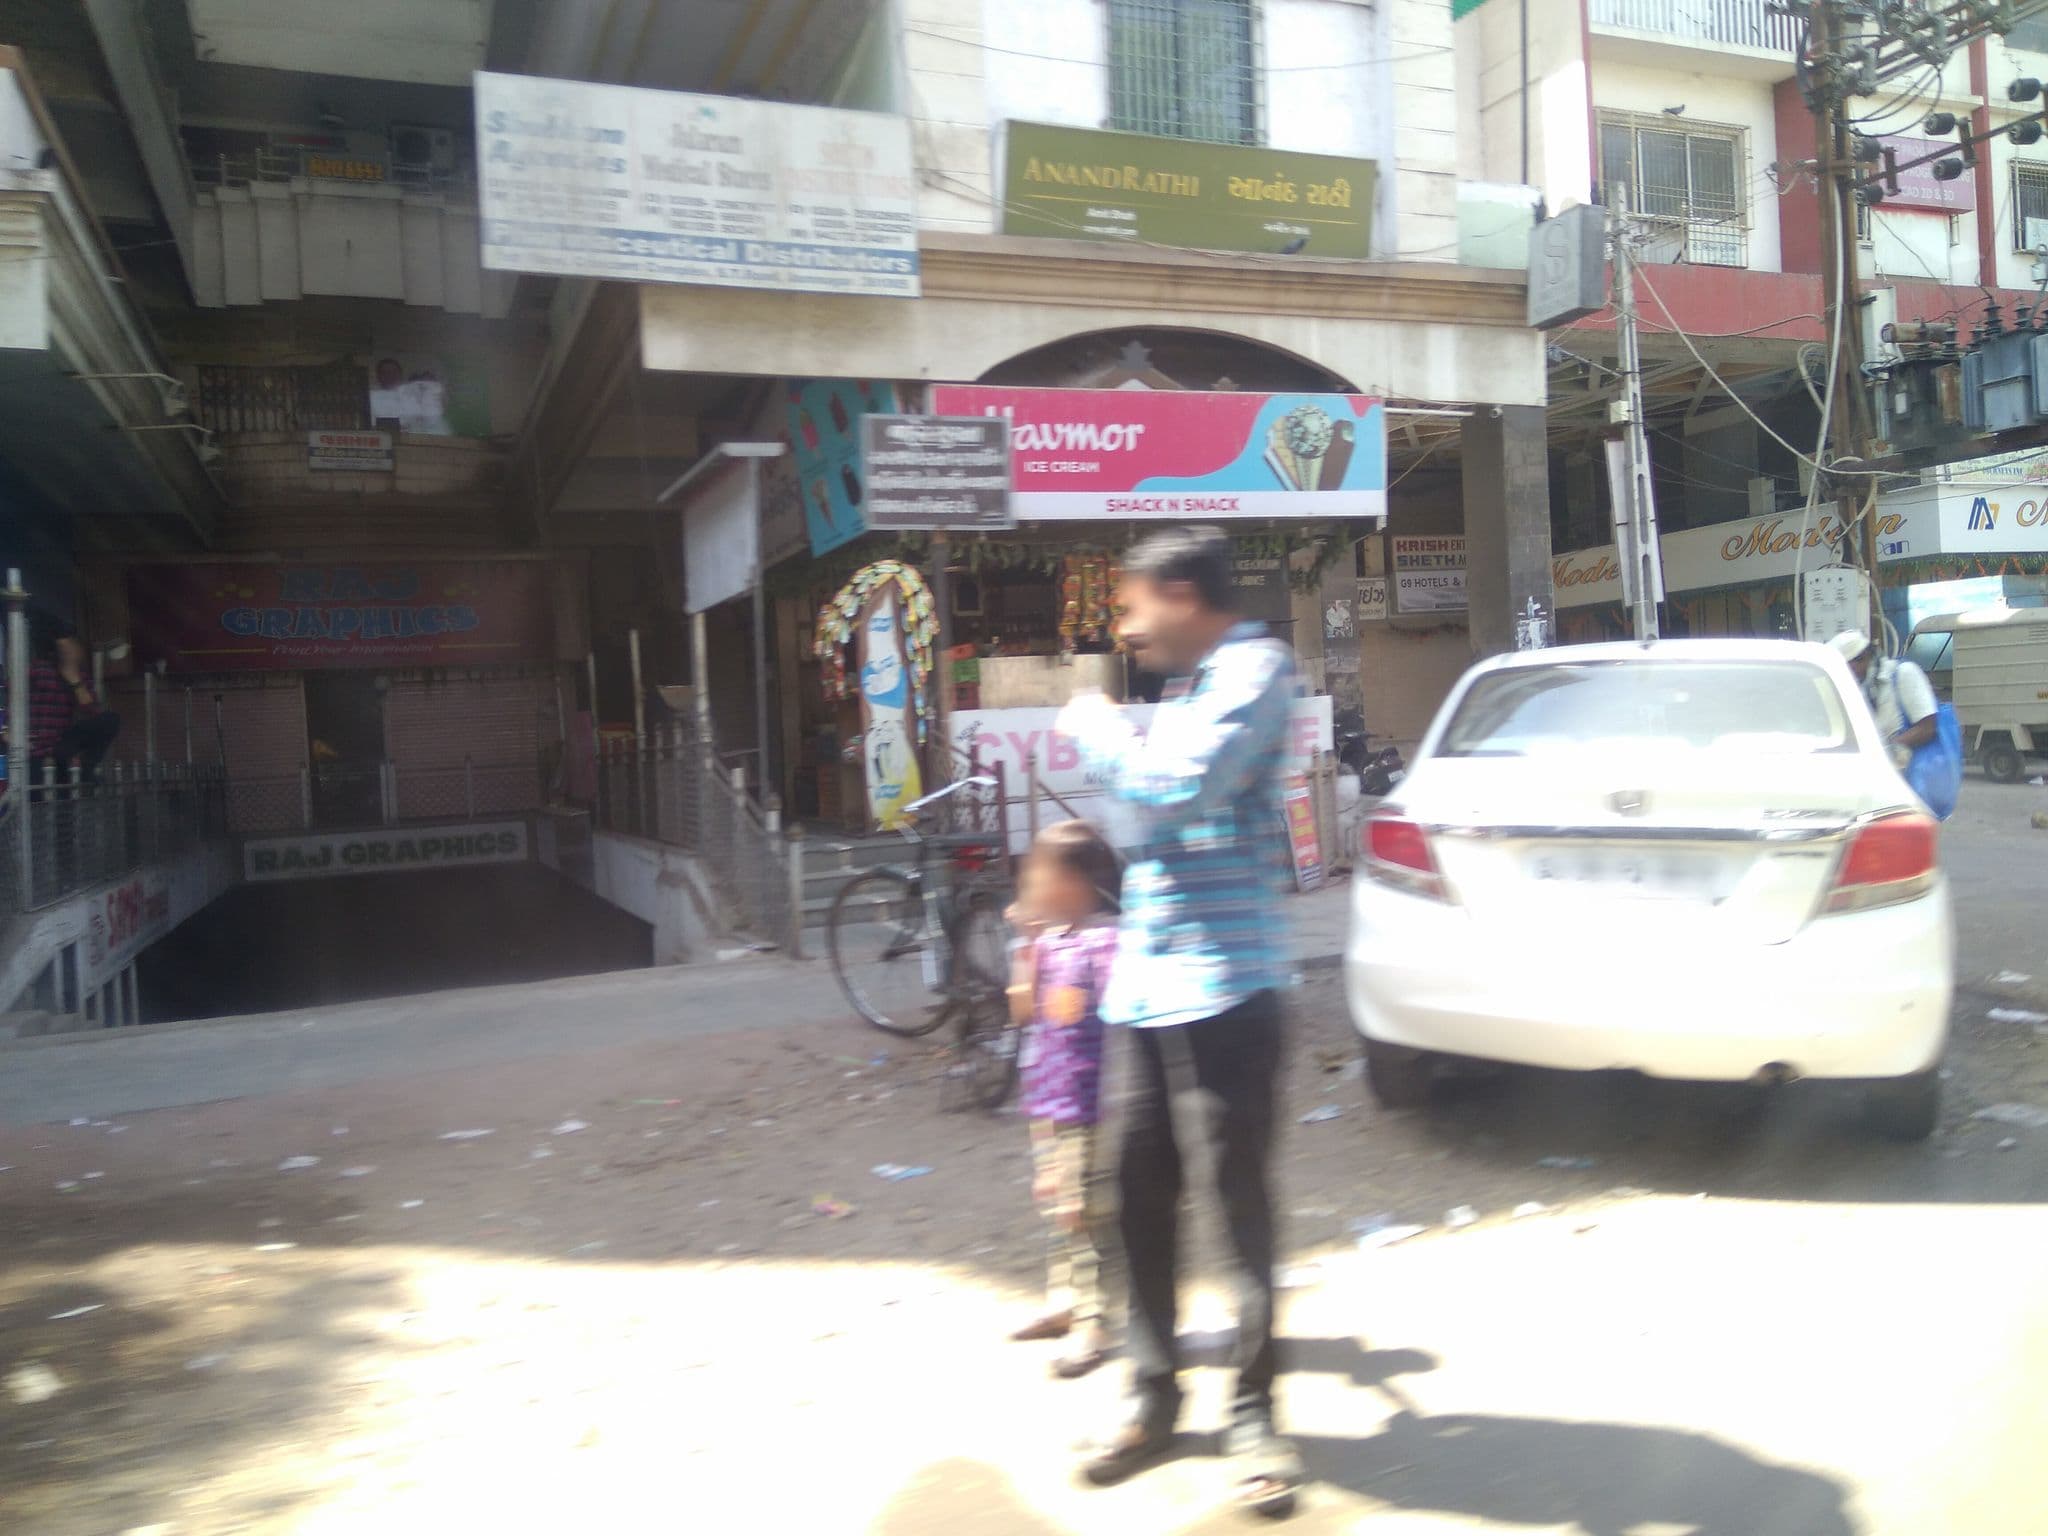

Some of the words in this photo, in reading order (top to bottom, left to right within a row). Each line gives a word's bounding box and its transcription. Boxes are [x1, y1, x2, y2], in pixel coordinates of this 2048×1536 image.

[1024, 461, 1048, 473] ICE
[1051, 461, 1100, 473] CREAM
[1106, 498, 1164, 513] SHACK
[1168, 498, 1180, 512] N
[1184, 498, 1240, 512] SNACK
[1721, 513, 1907, 560] Moden
[1396, 539, 1448, 552] KRISH
[1397, 554, 1456, 567] SHETH
[1415, 577, 1448, 588] HOTELS
[1453, 576, 1462, 586] &
[220, 604, 481, 640] GRAPHICS
[253, 845, 332, 874] RAJ
[341, 831, 519, 866] GRAPHICS
